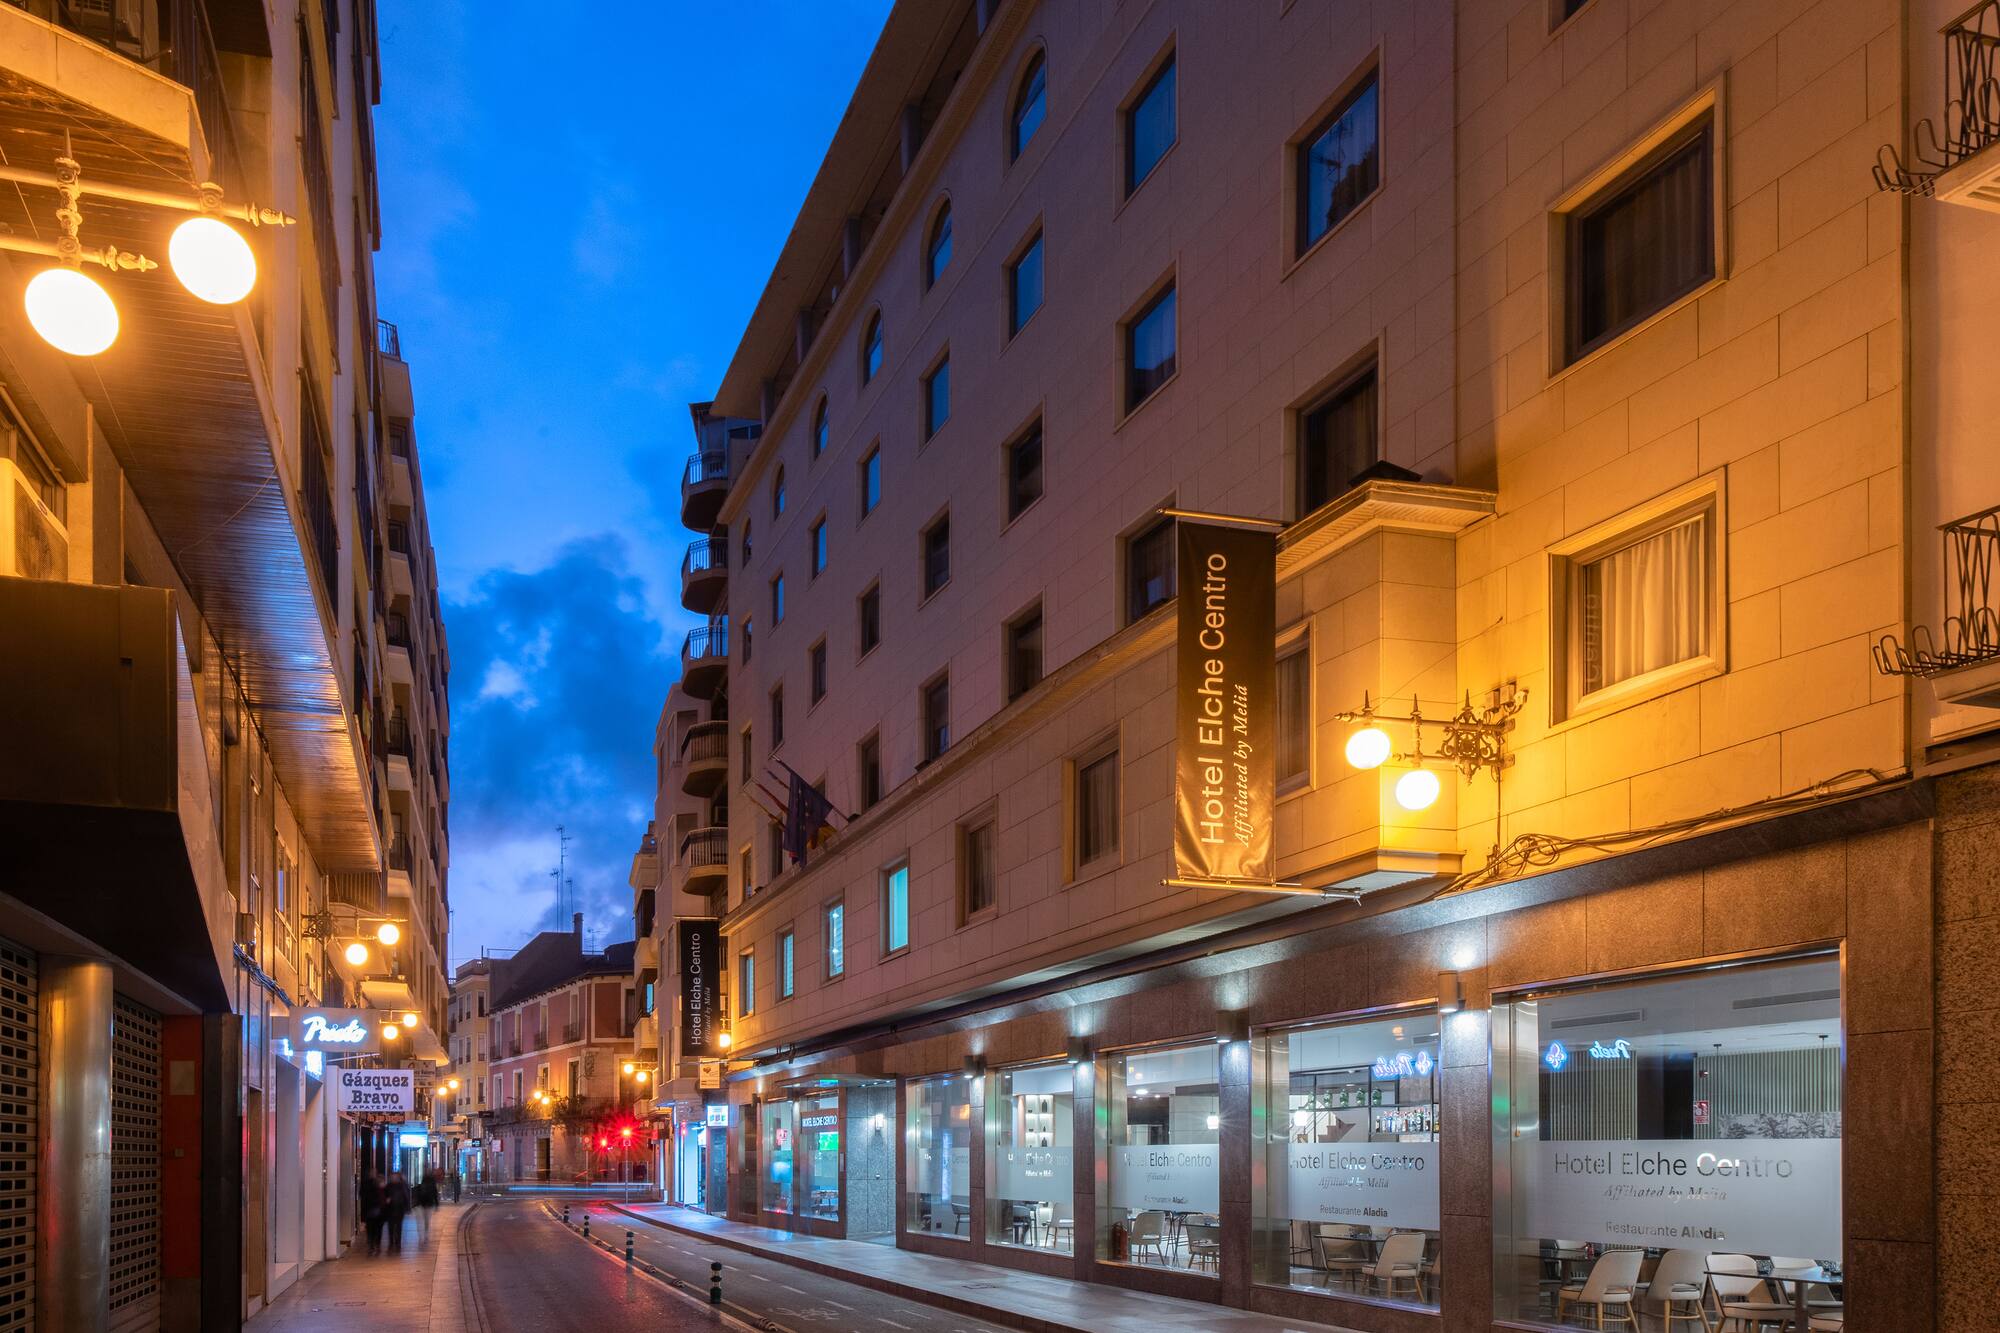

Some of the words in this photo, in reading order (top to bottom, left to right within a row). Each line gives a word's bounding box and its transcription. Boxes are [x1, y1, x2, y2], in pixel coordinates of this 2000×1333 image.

[1199, 553, 1227, 651] Centro
[1197, 658, 1224, 746] Elche
[1233, 685, 1249, 737] Meliá
[1233, 739, 1253, 759] by
[1200, 757, 1225, 844] Hotel
[1232, 763, 1250, 848] Affiliated
[690, 933, 701, 975] Centro
[690, 977, 701, 1010] Elche
[691, 1013, 701, 1045] Hotel
[342, 1071, 409, 1090] Gázquez
[351, 1090, 399, 1104] Bravo
[1177, 1152, 1213, 1168] Centro
[1328, 1152, 1367, 1170] Elche
[1371, 1153, 1425, 1171] Centro
[1553, 1151, 1612, 1175] Hotel
[1622, 1151, 1687, 1176] Elche
[1696, 1152, 1794, 1179] Centro
[1320, 1204, 1361, 1217] Restaurante
[1605, 1221, 1678, 1237] Restaurante
